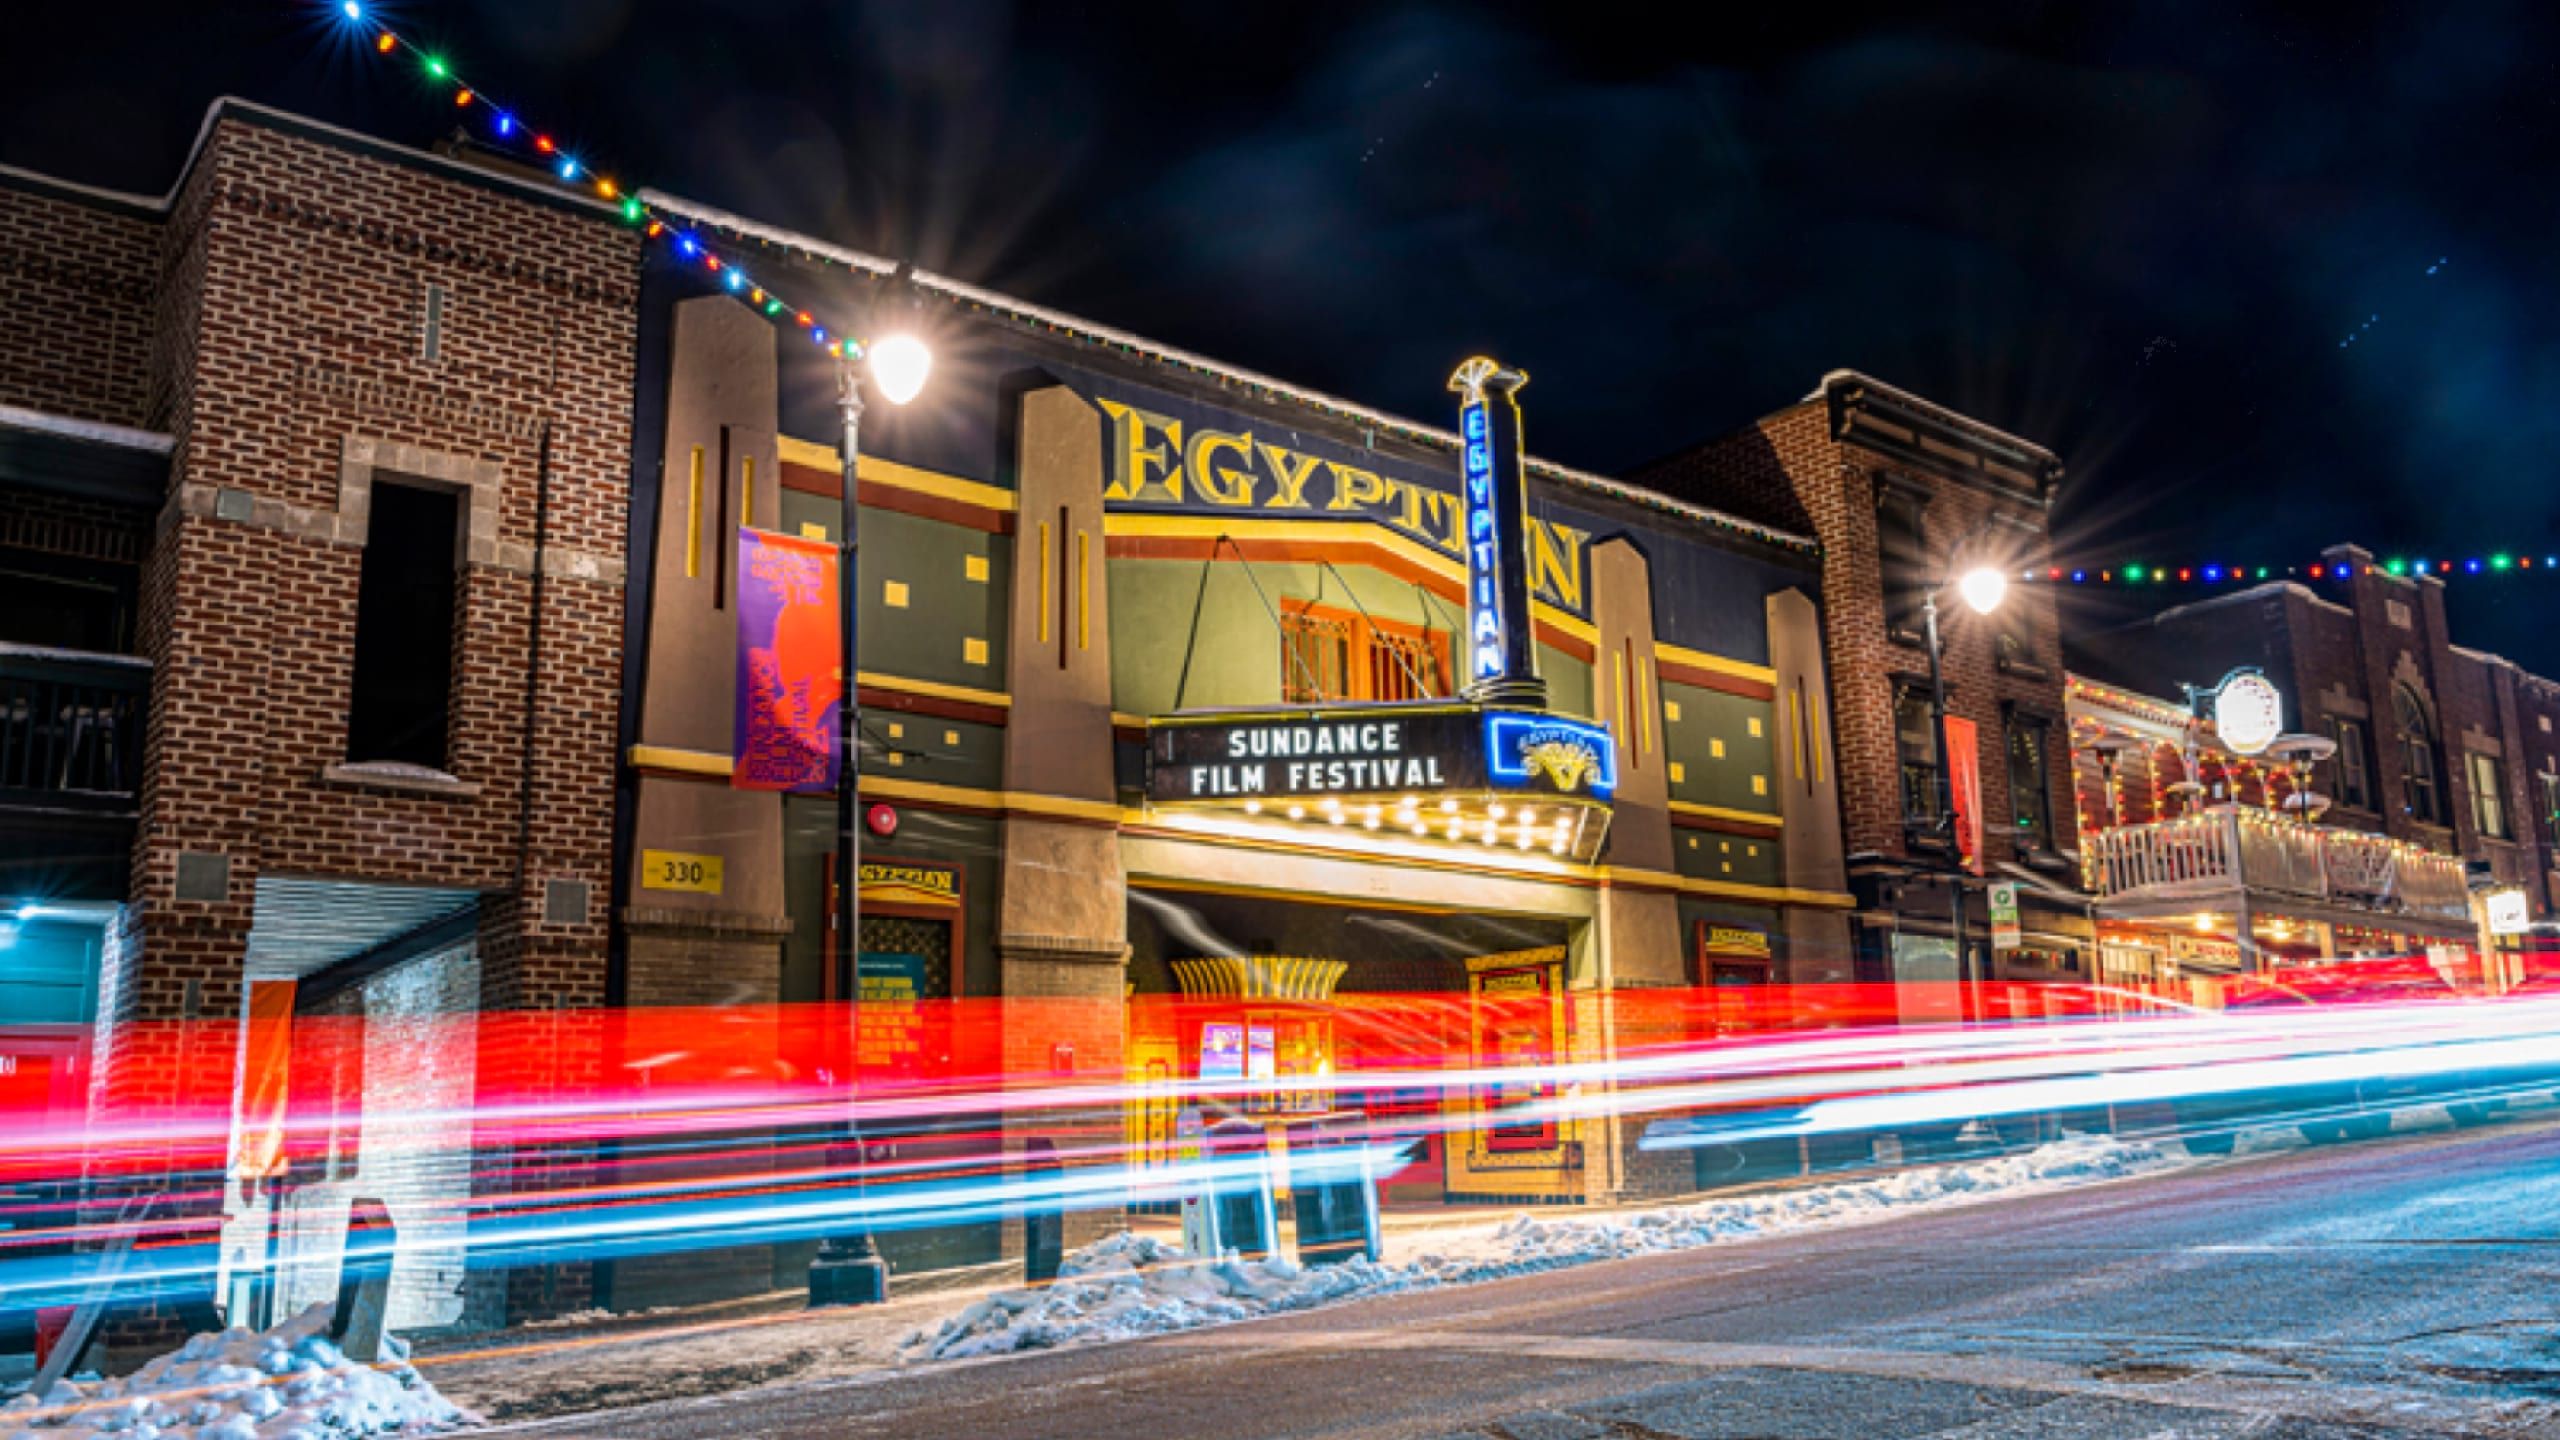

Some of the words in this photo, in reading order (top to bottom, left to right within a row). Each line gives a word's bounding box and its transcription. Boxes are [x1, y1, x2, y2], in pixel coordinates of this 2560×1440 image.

[1095, 396, 1592, 609] EGYPTIN
[1468, 410, 1500, 676] EGYPTIAN
[1228, 724, 1401, 758] SUNDANCE
[1191, 764, 1265, 795] FILM
[1288, 756, 1445, 791] FESTIVAL
[664, 861, 704, 885] 330
